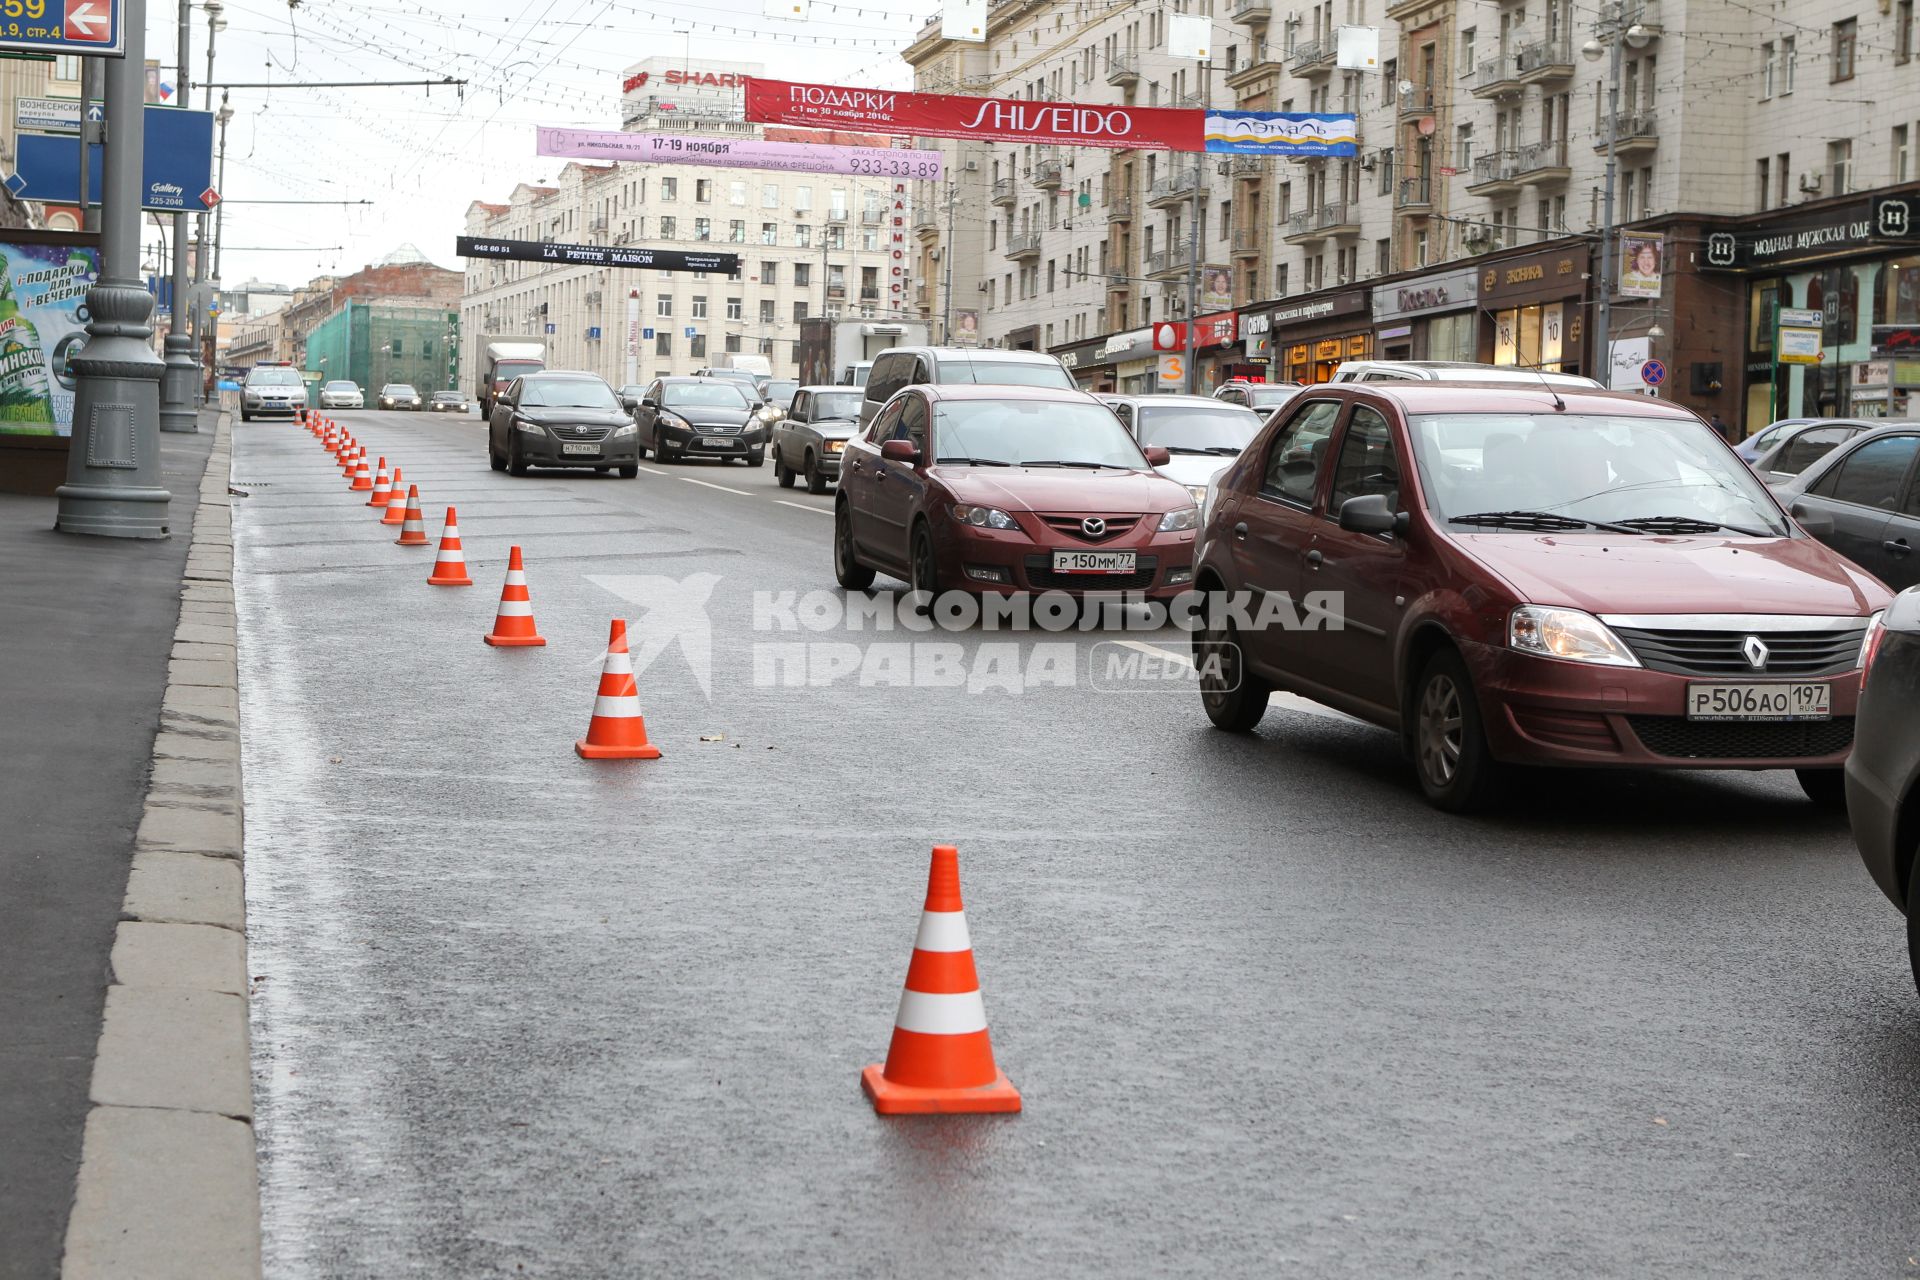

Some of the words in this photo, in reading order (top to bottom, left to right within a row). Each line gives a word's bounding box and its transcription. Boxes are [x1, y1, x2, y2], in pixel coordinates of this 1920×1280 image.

[665, 70, 752, 88] SHARP
[20, 101, 82, 112] ВОЗНЕСЕНСКИ
[790, 86, 896, 111] ПОДАРКИ
[833, 110, 864, 119] ноября
[960, 100, 1131, 135] SHISEIDO
[652, 138, 682, 150] 17-19
[686, 141, 730, 155] ноября
[760, 160, 788, 168] ЭРИКА
[790, 161, 834, 171] ФРЕШОНА
[850, 158, 939, 177] 933-33-89
[151, 182, 183, 197] Gallery
[150, 197, 183, 206] 225-2040
[1754, 234, 1793, 256] МОДНАЯ
[1797, 225, 1846, 248] МУЖСКАЯ
[543, 248, 558, 257] LA
[566, 250, 604, 261] PETITE
[611, 253, 654, 264] MAISON
[1506, 265, 1544, 284] ЭКОНИКА
[49, 278, 72, 292] ДЛЯ
[1248, 314, 1269, 335] ОБУВЬ
[1119, 554, 1132, 565] 77
[1696, 688, 1788, 713] Р506АО
[1792, 685, 1825, 705] 197
